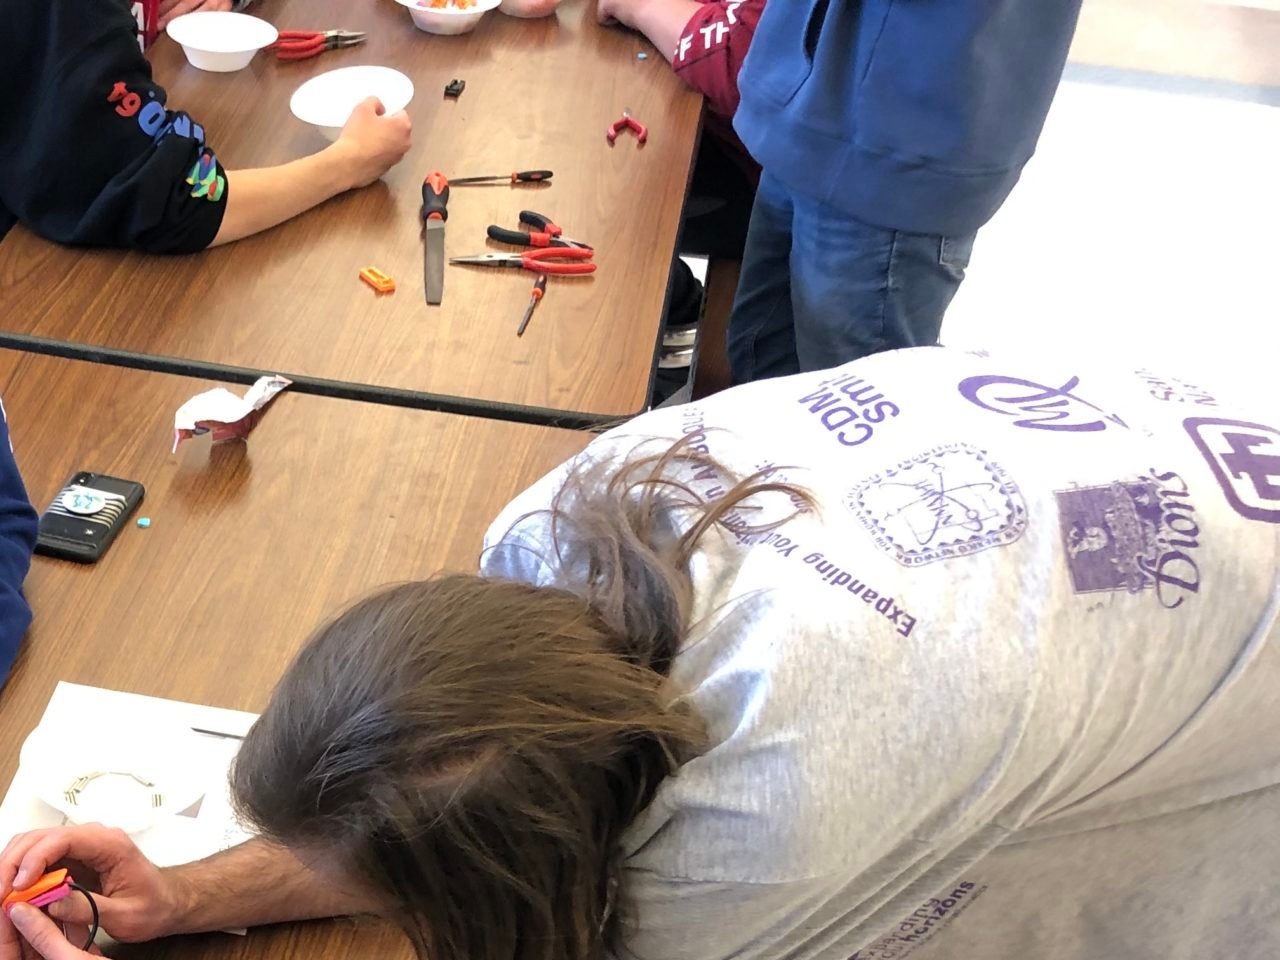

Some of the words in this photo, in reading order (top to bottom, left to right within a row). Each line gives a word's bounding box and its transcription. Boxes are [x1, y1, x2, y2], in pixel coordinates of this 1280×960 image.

[797, 387, 874, 446] CDM
[759, 532, 800, 558] Your
[1136, 467, 1200, 609] Dion's
[803, 552, 918, 638] Expanding
[898, 880, 976, 944] horizons
